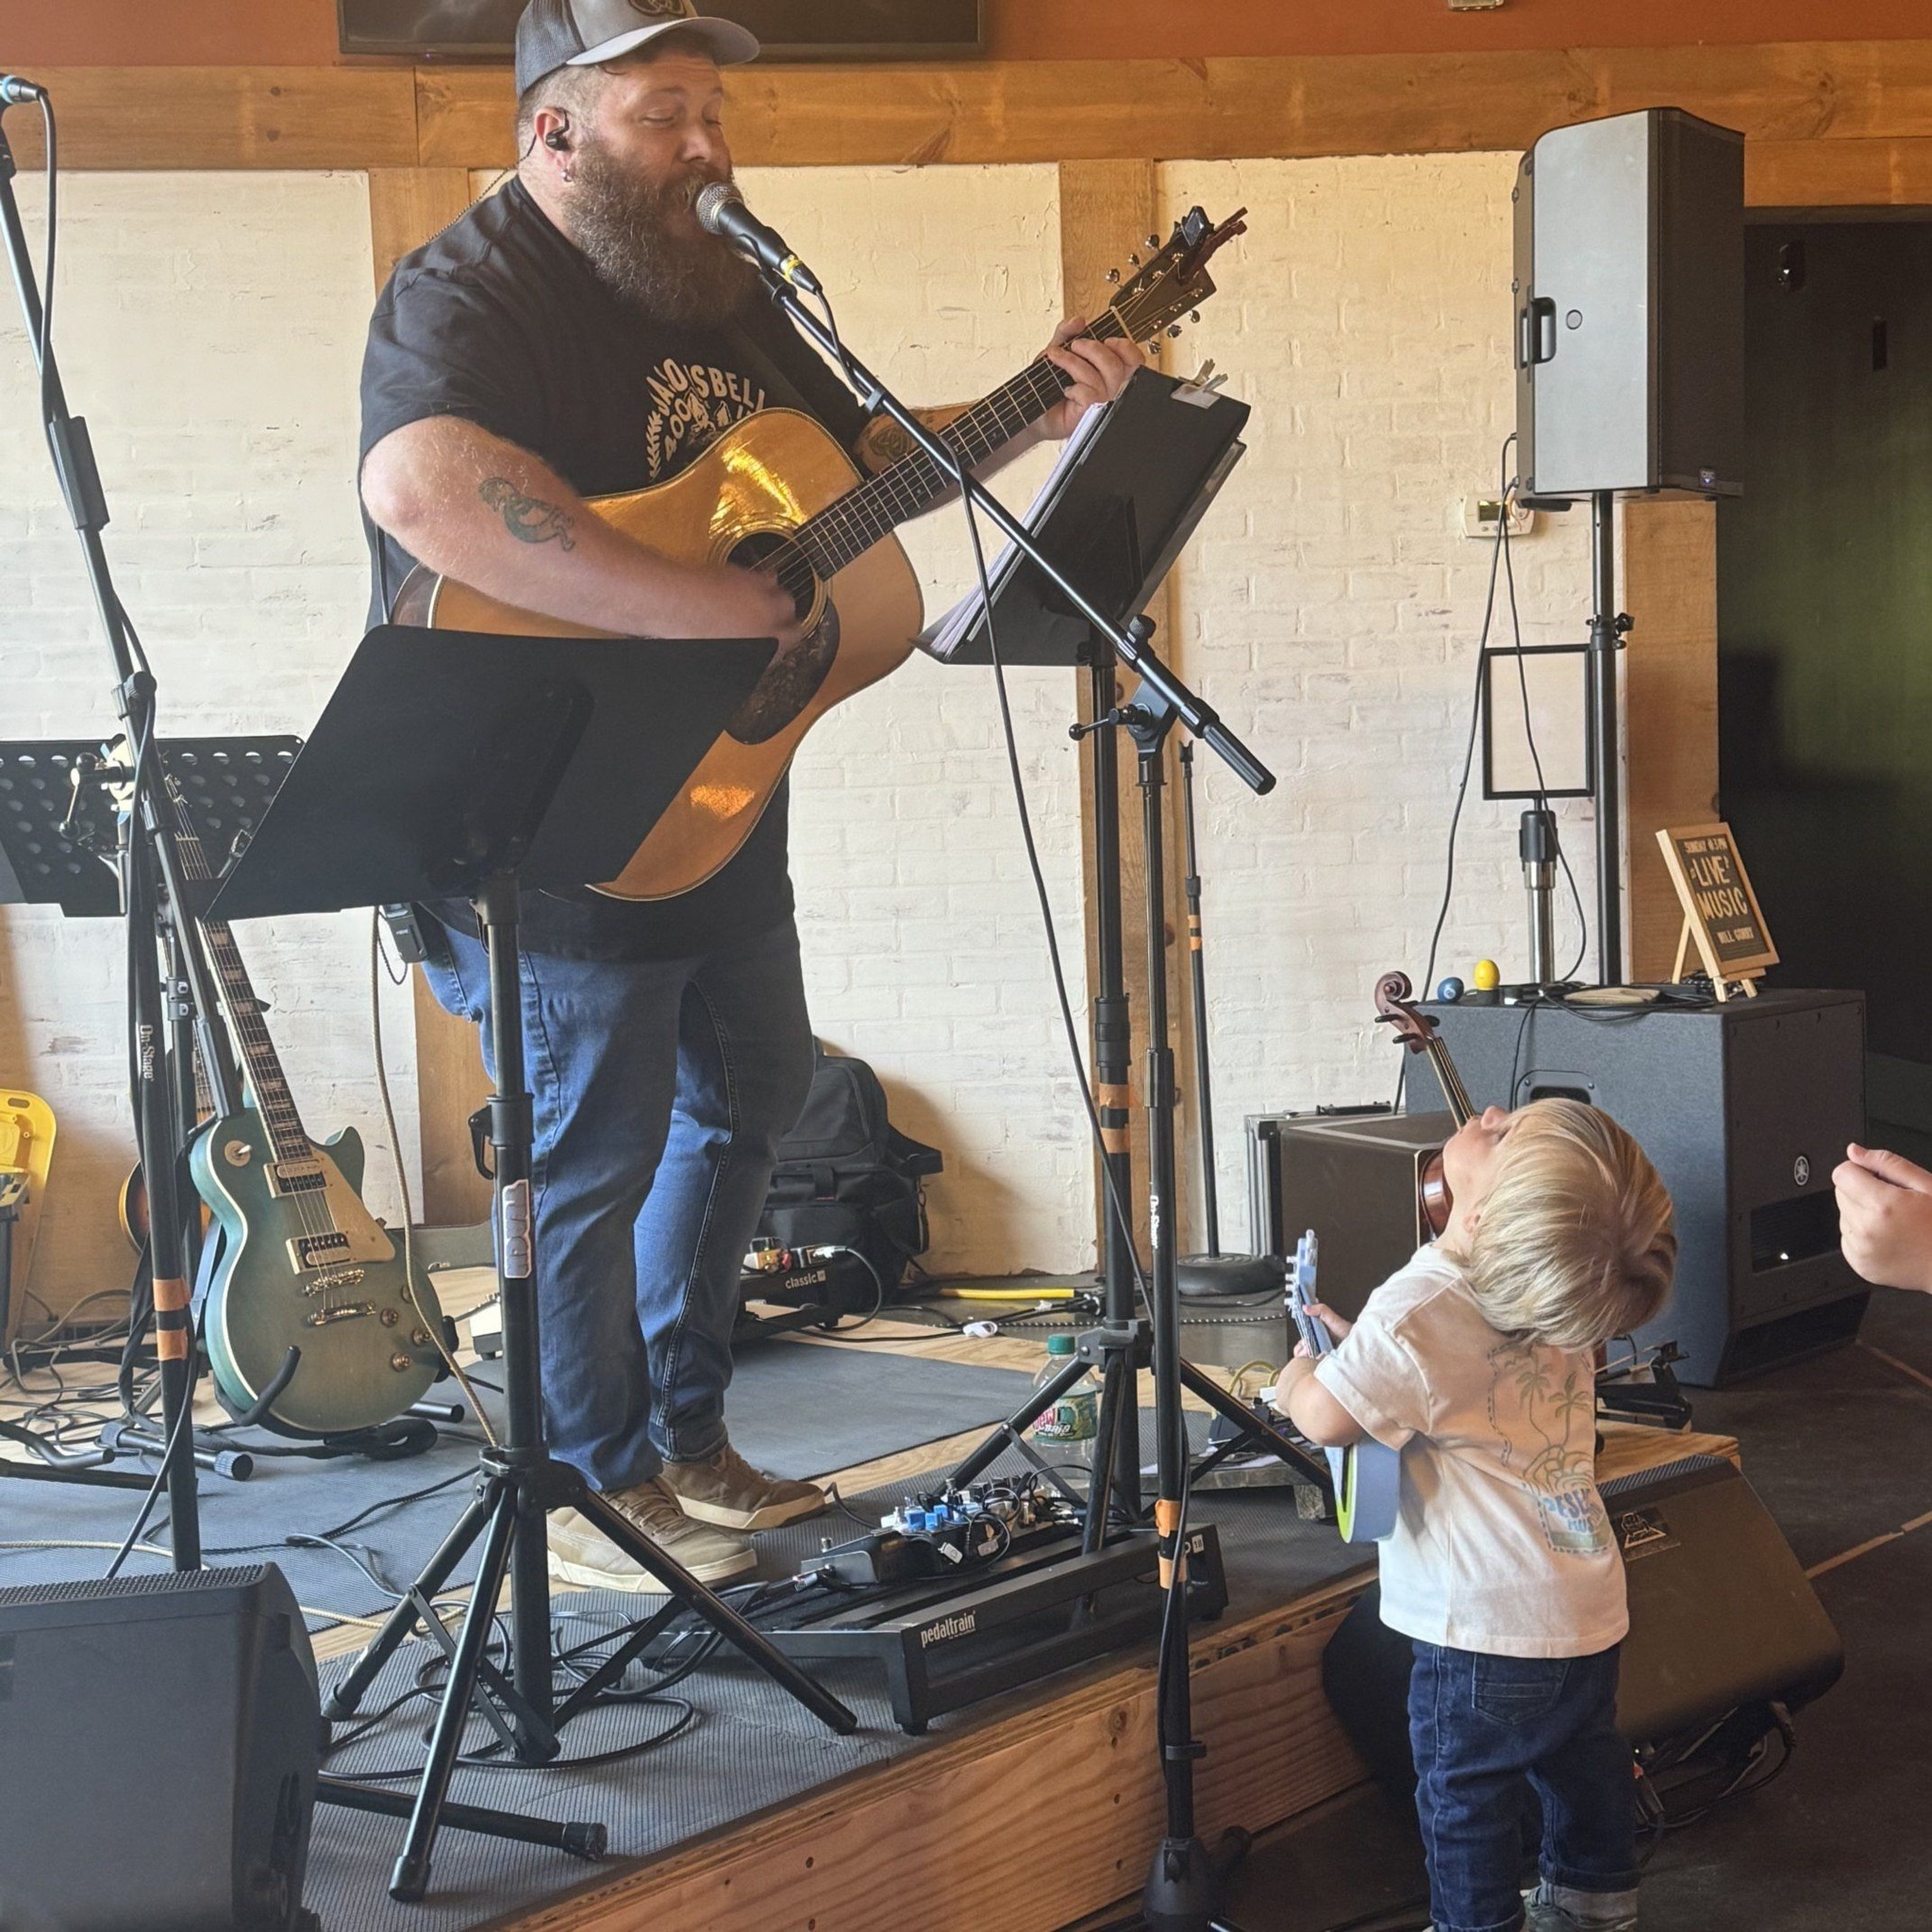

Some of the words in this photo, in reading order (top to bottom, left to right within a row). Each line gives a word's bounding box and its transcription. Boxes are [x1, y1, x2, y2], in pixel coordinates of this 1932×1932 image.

[1691, 856, 1731, 887] LIVE
[1696, 887, 1748, 922] MUSIC
[785, 1273, 818, 1290] classic
[920, 1612, 976, 1649] pedaltrain
